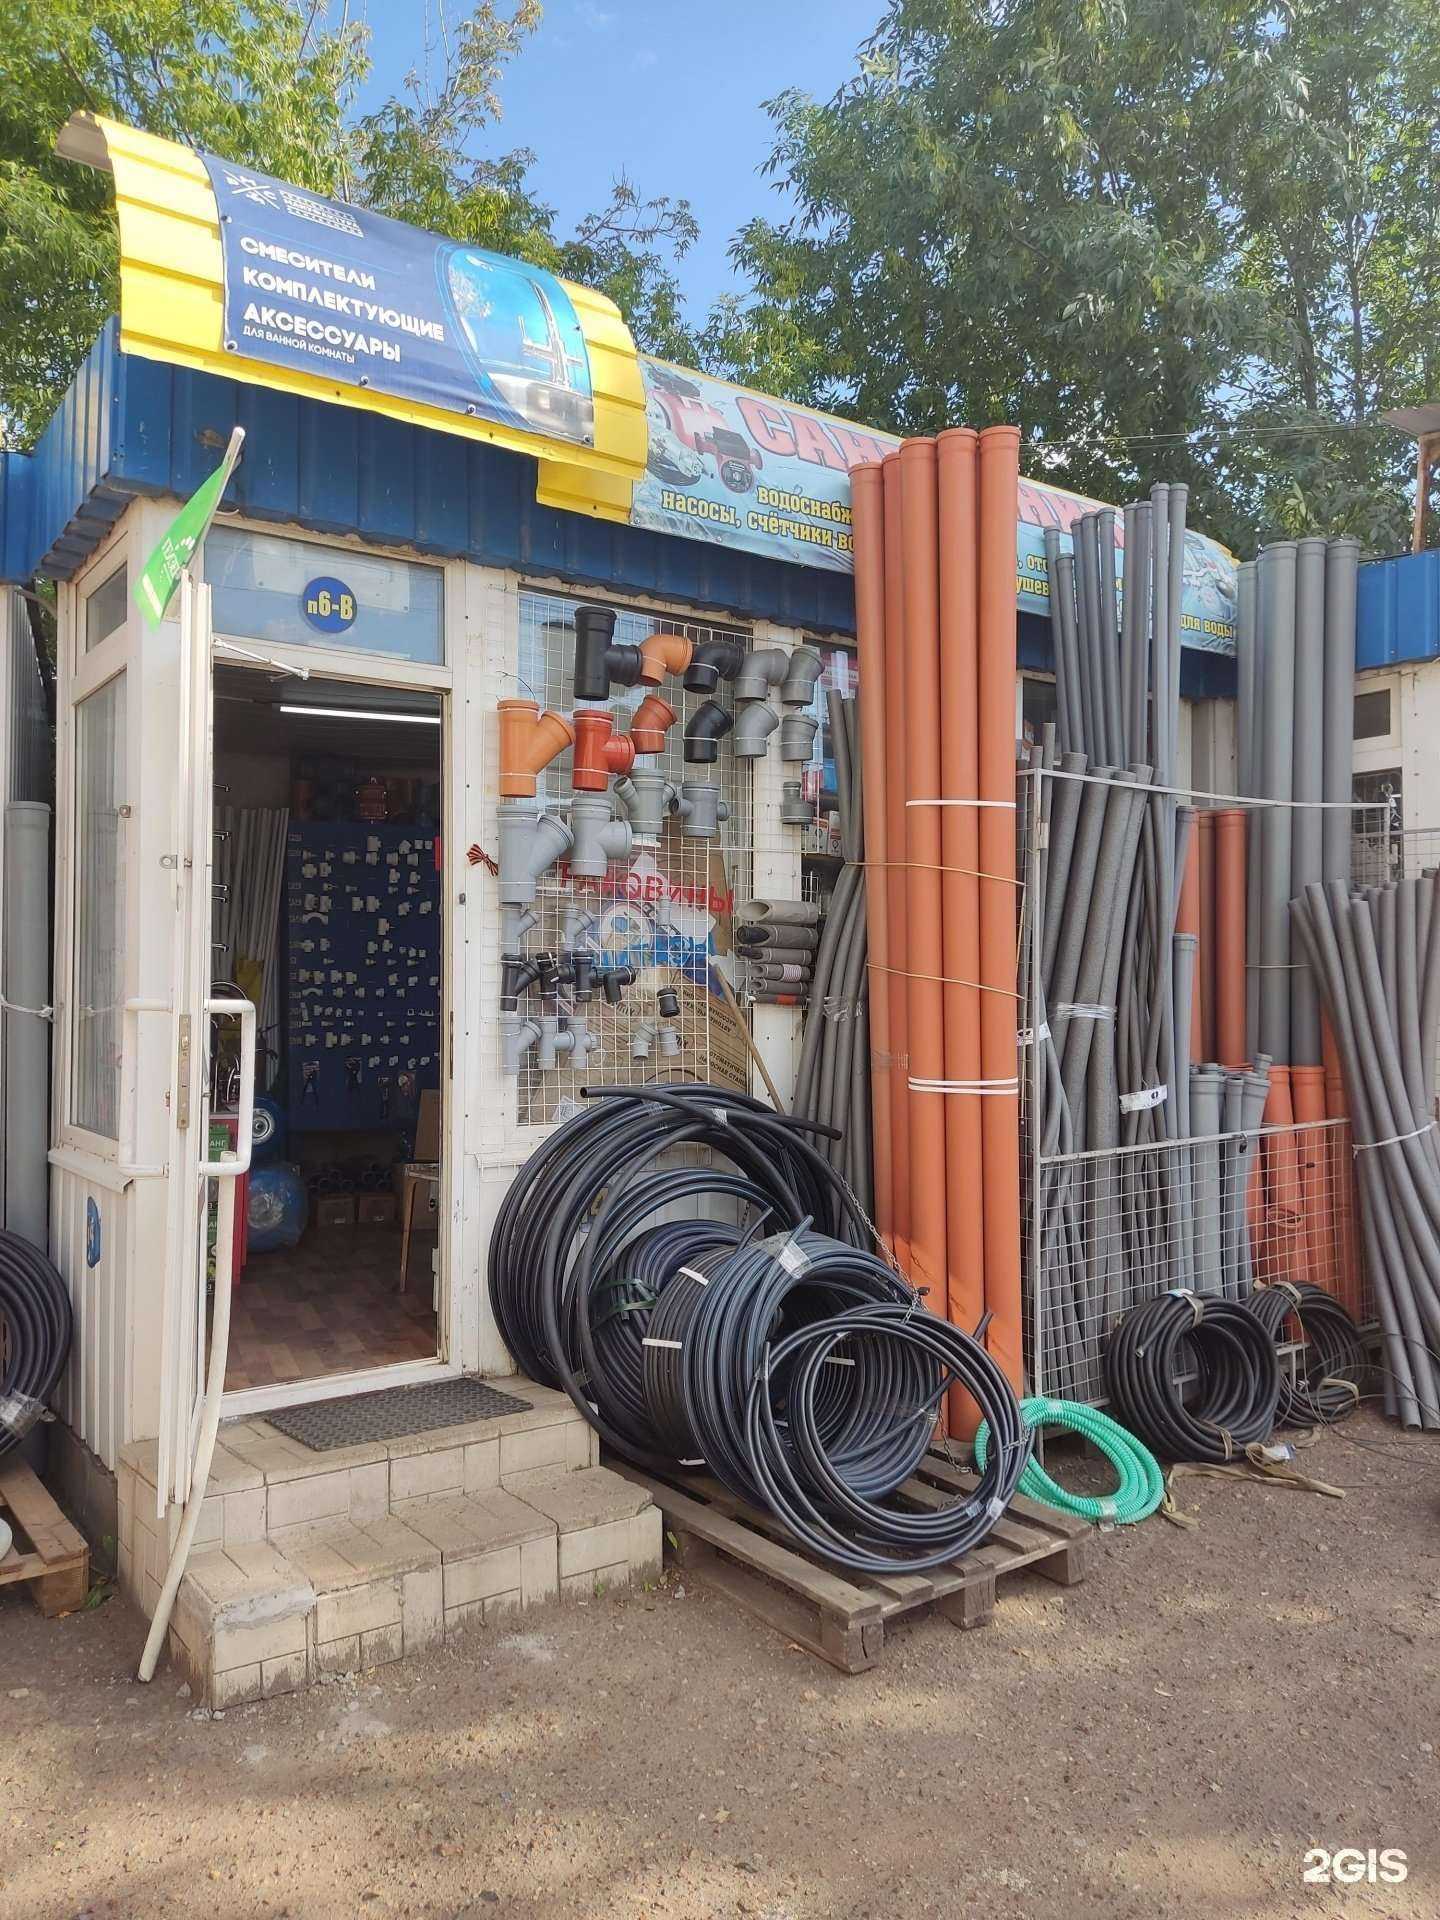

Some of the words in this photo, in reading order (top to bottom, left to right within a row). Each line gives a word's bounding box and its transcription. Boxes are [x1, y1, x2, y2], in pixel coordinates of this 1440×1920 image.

[240, 237, 376, 290] СМЕСИТЕЛИ
[243, 267, 445, 342] КОМПЛЕКТУЮЩИЕ
[243, 303, 400, 362] АКСЕССУАРЫ
[243, 325, 265, 339] ДЛЯ
[266, 329, 307, 351] ВАННОЙ
[308, 343, 355, 364] КОМНАТЫ
[757, 485, 853, 525] водоснабж
[661, 489, 741, 528] насосы,
[747, 511, 833, 548] счётчики
[837, 532, 854, 553] во
[1016, 574, 1049, 597] ушев
[1203, 619, 1233, 639] воды
